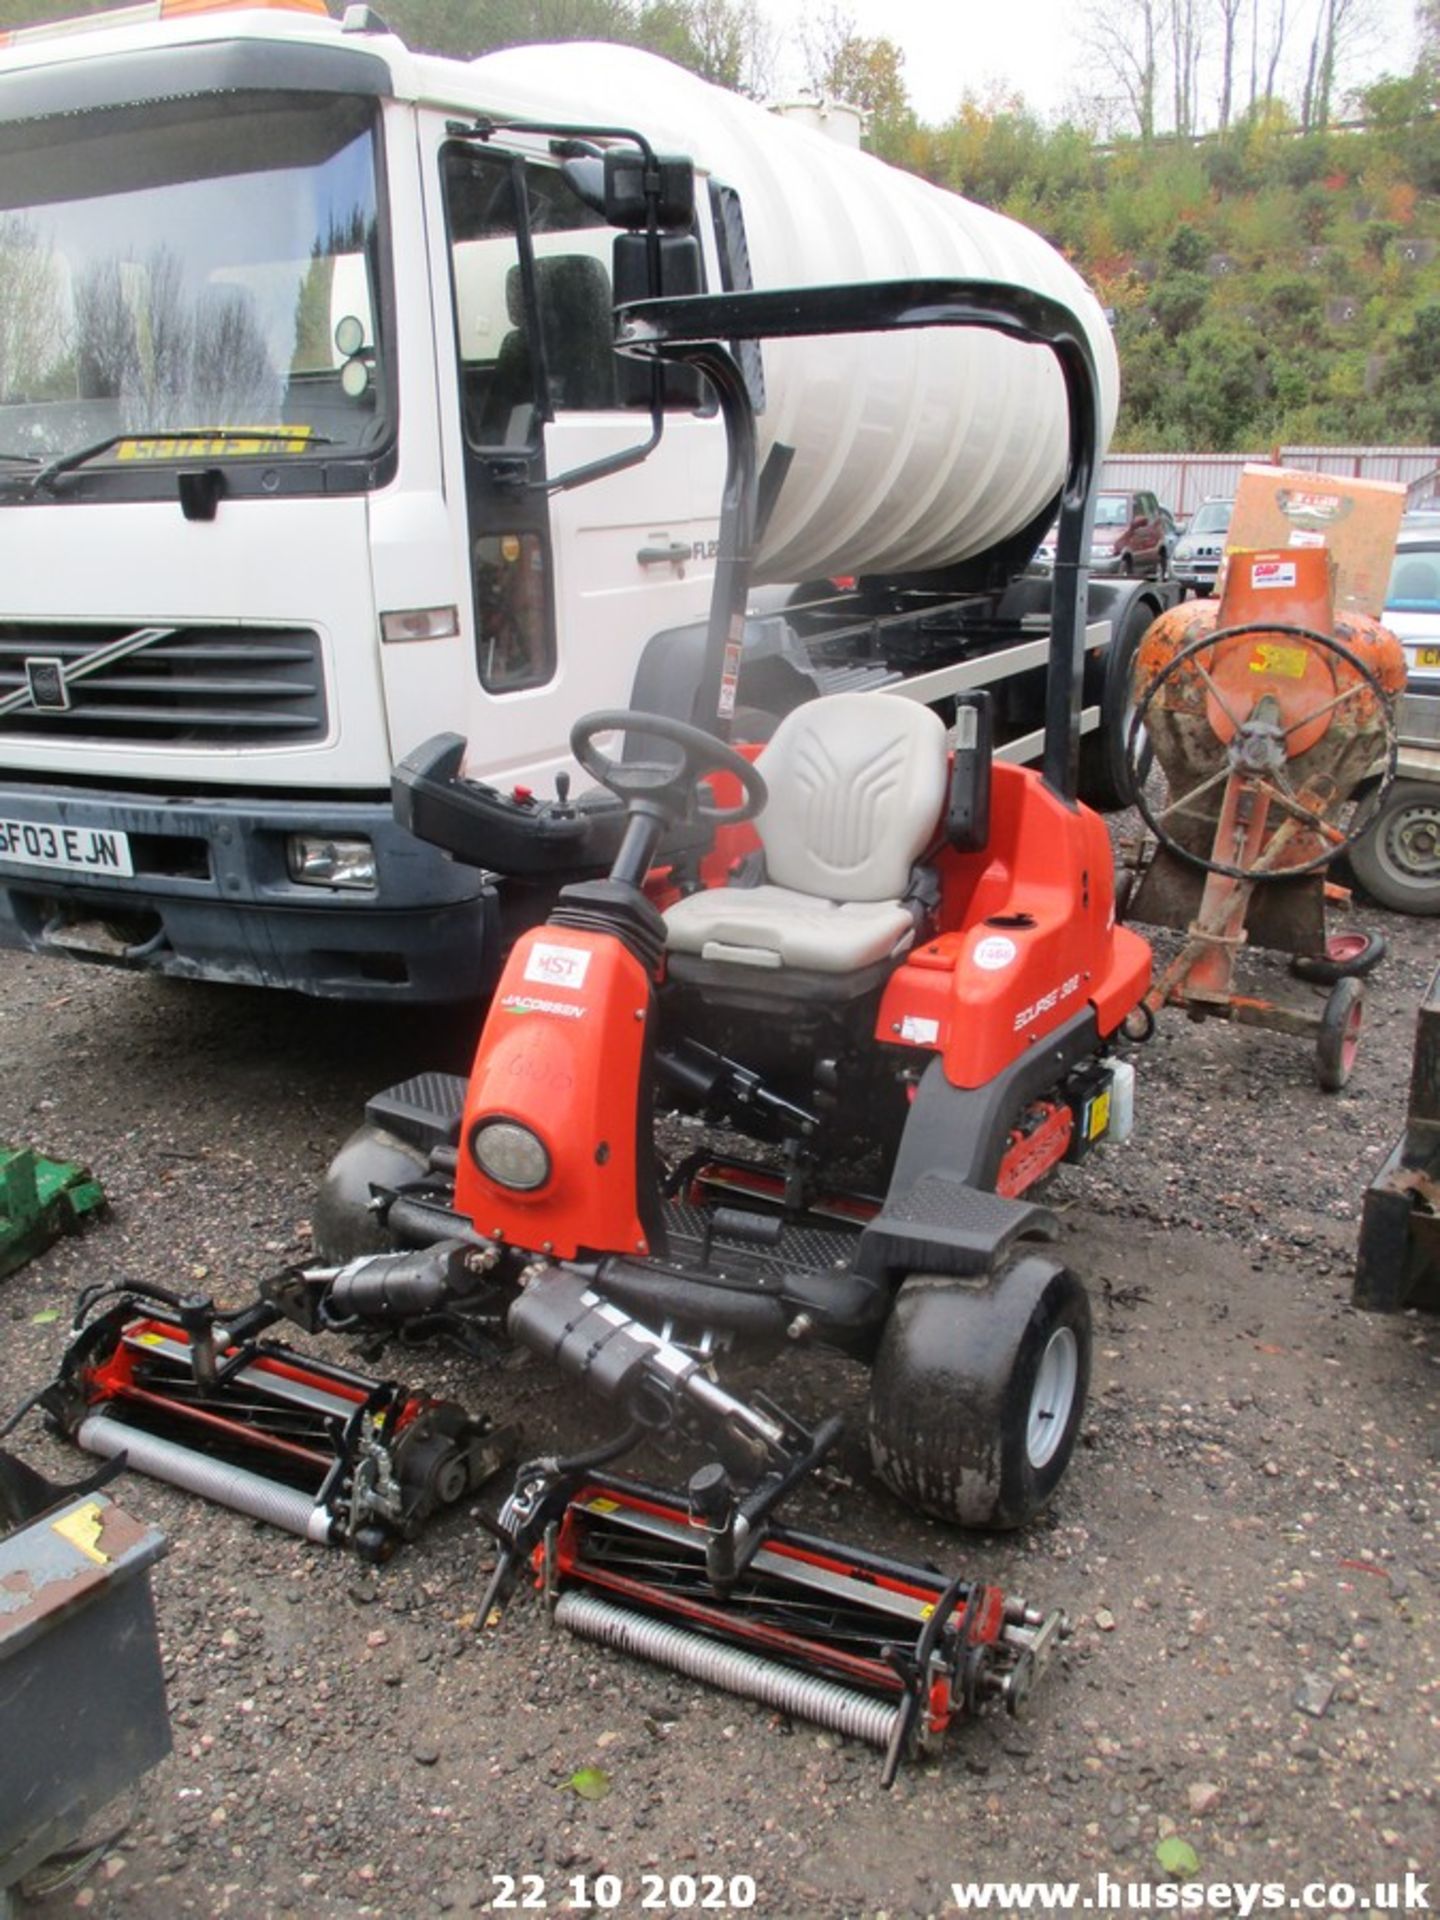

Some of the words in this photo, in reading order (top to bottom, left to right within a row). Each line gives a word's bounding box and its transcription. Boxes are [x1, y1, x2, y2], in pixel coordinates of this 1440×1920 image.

[62, 829, 119, 867] EJN
[537, 955, 578, 975] MST
[501, 994, 587, 1019] JACOBSEN
